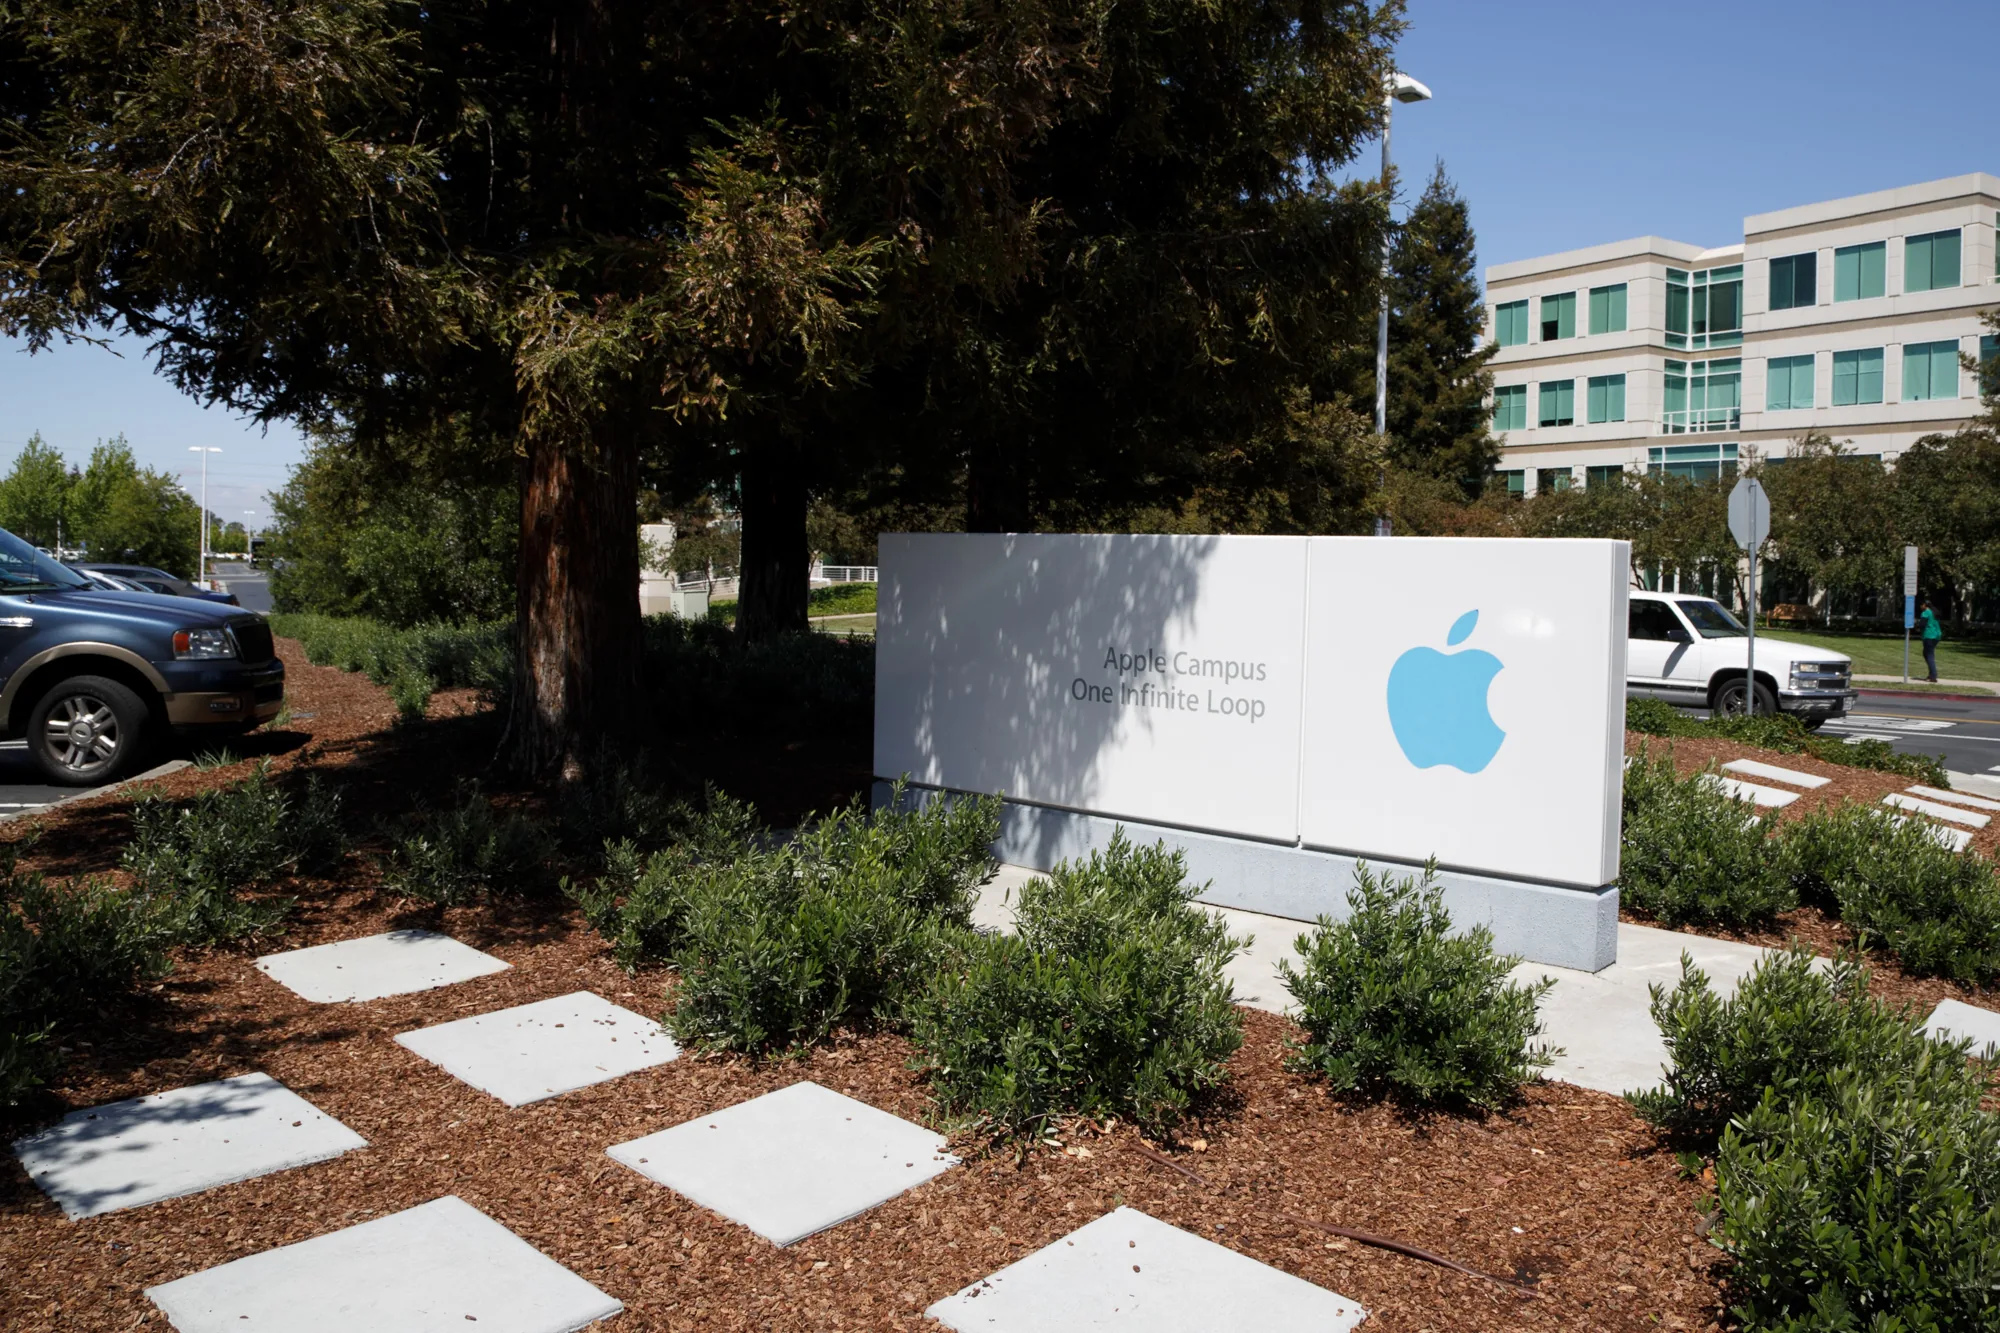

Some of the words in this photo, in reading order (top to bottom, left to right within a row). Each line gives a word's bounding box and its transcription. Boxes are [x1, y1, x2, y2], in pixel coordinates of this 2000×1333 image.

[1104, 646, 1167, 677] Apple
[1173, 651, 1267, 685] Campus
[1071, 678, 1113, 704] One
[1120, 682, 1199, 712] Infinite
[1207, 689, 1265, 724] Loop
